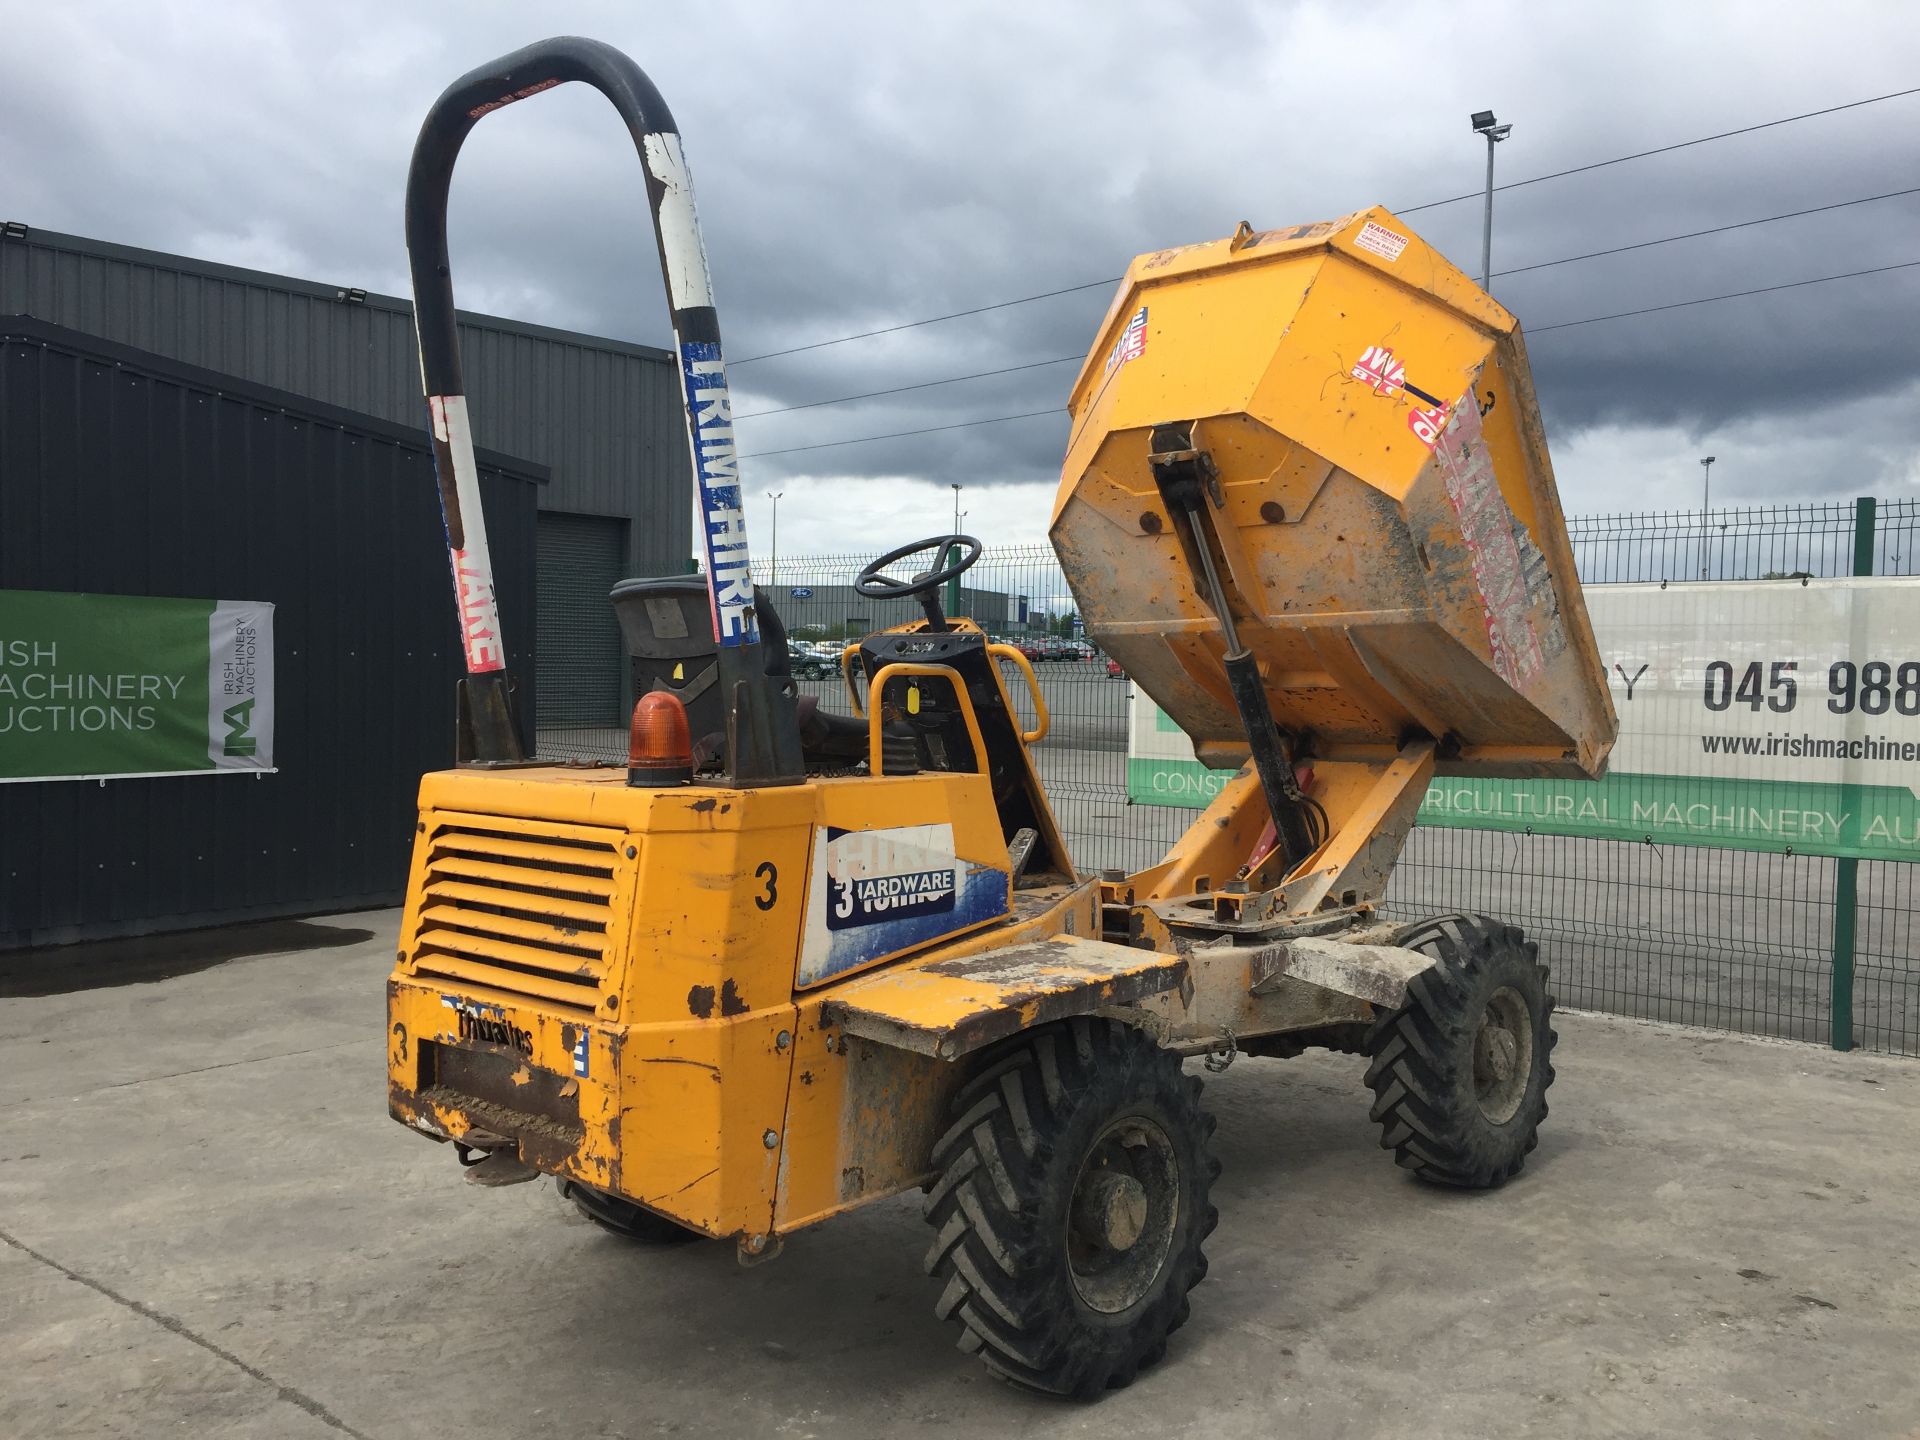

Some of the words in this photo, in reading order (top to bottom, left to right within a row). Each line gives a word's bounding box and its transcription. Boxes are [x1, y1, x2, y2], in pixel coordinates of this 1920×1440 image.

[1367, 222, 1408, 245] WARNING
[709, 508, 759, 638] HIRE
[223, 662, 234, 695] IRISH
[235, 618, 246, 695] MACHINERY
[246, 628, 256, 695] AUCTIONS
[1704, 660, 1798, 713] 045
[1827, 661, 1920, 716] 988
[1420, 788, 1618, 824] RICULTURAL
[1632, 800, 1850, 839] MACHINERY
[755, 861, 778, 911] 3
[834, 873, 854, 919] 3
[392, 1021, 408, 1062] 3
